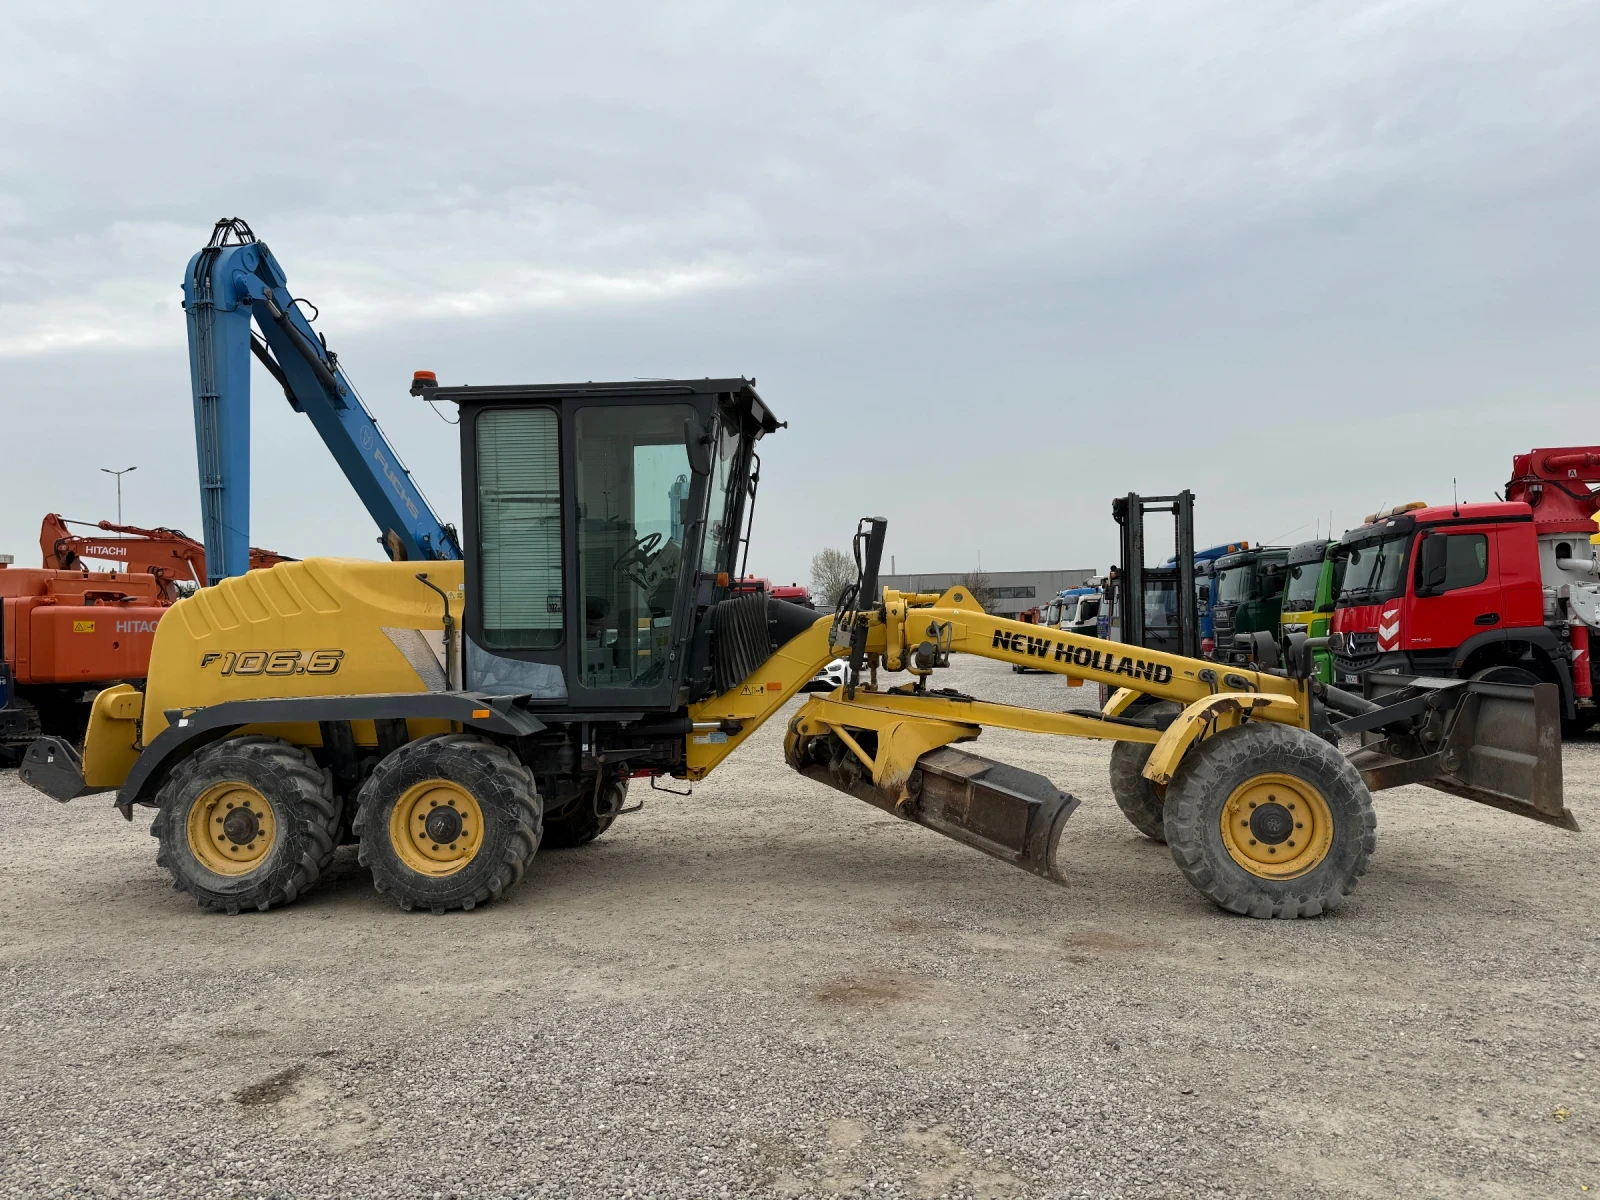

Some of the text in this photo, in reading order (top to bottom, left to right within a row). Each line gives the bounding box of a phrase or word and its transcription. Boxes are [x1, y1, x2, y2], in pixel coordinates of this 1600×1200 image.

[374, 448, 419, 520] FUCHS
[85, 545, 127, 556] HITACHI
[992, 629, 1173, 685] NEW HOLLAND
